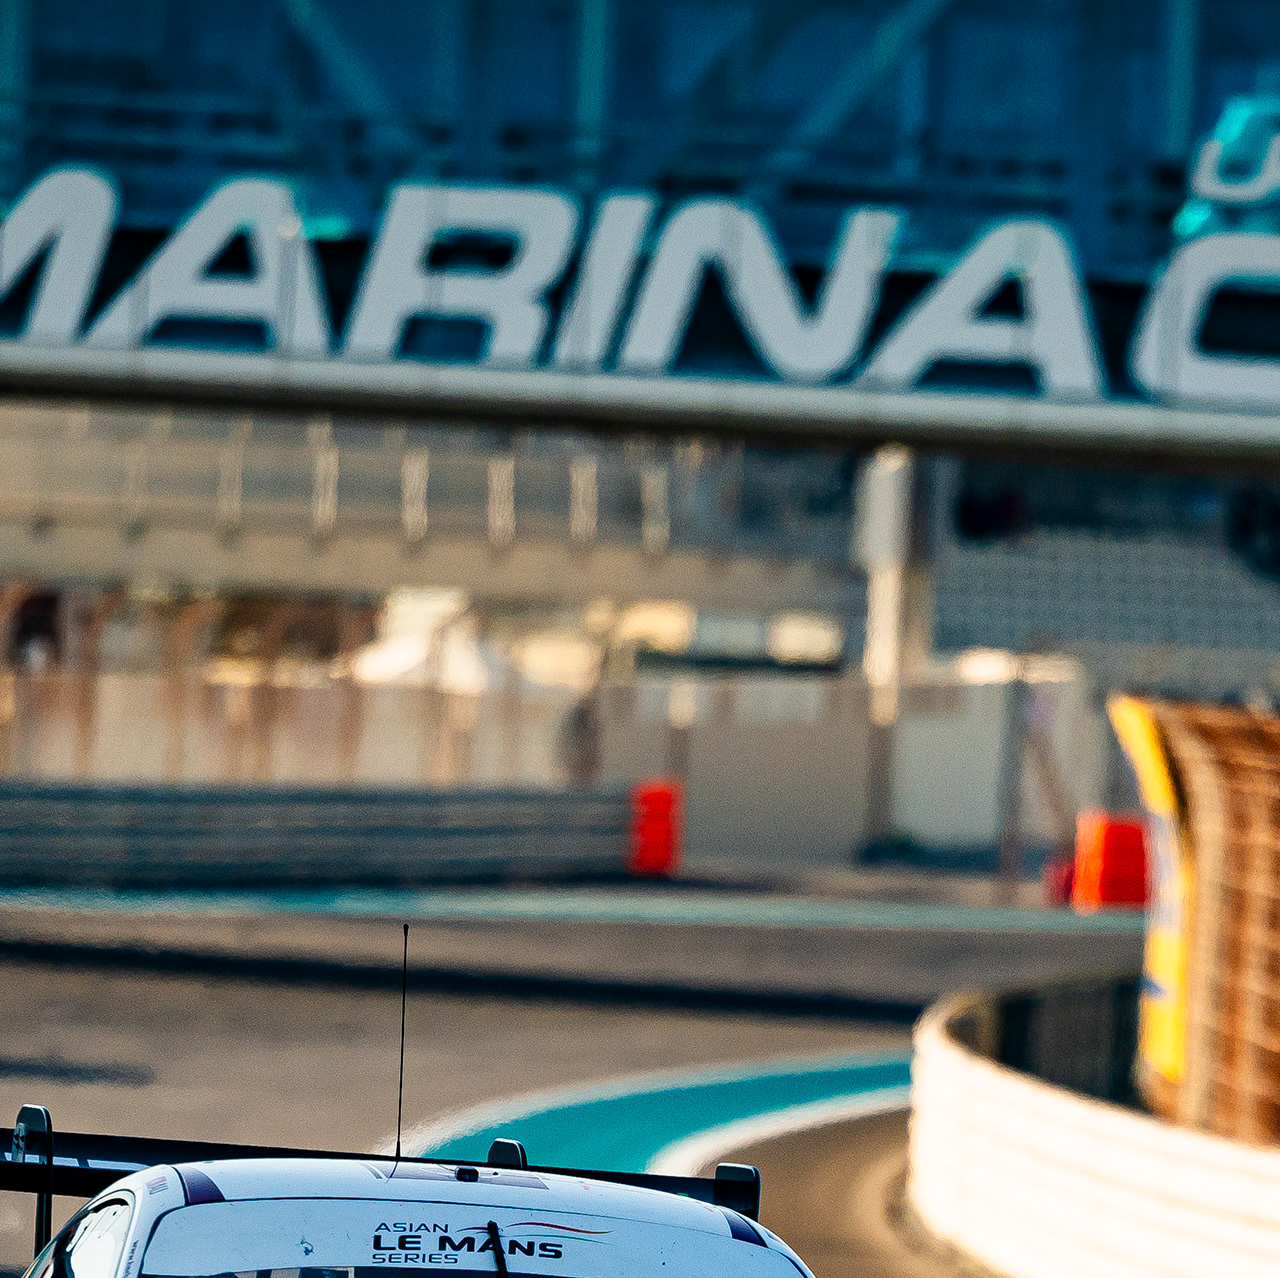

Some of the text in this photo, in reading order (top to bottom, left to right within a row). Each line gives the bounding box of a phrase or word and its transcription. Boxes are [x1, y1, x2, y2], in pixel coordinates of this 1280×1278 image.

[374, 1222, 449, 1233] ASIAN
[372, 1234, 563, 1259] LE MANS
[371, 1253, 459, 1264] SERIES
